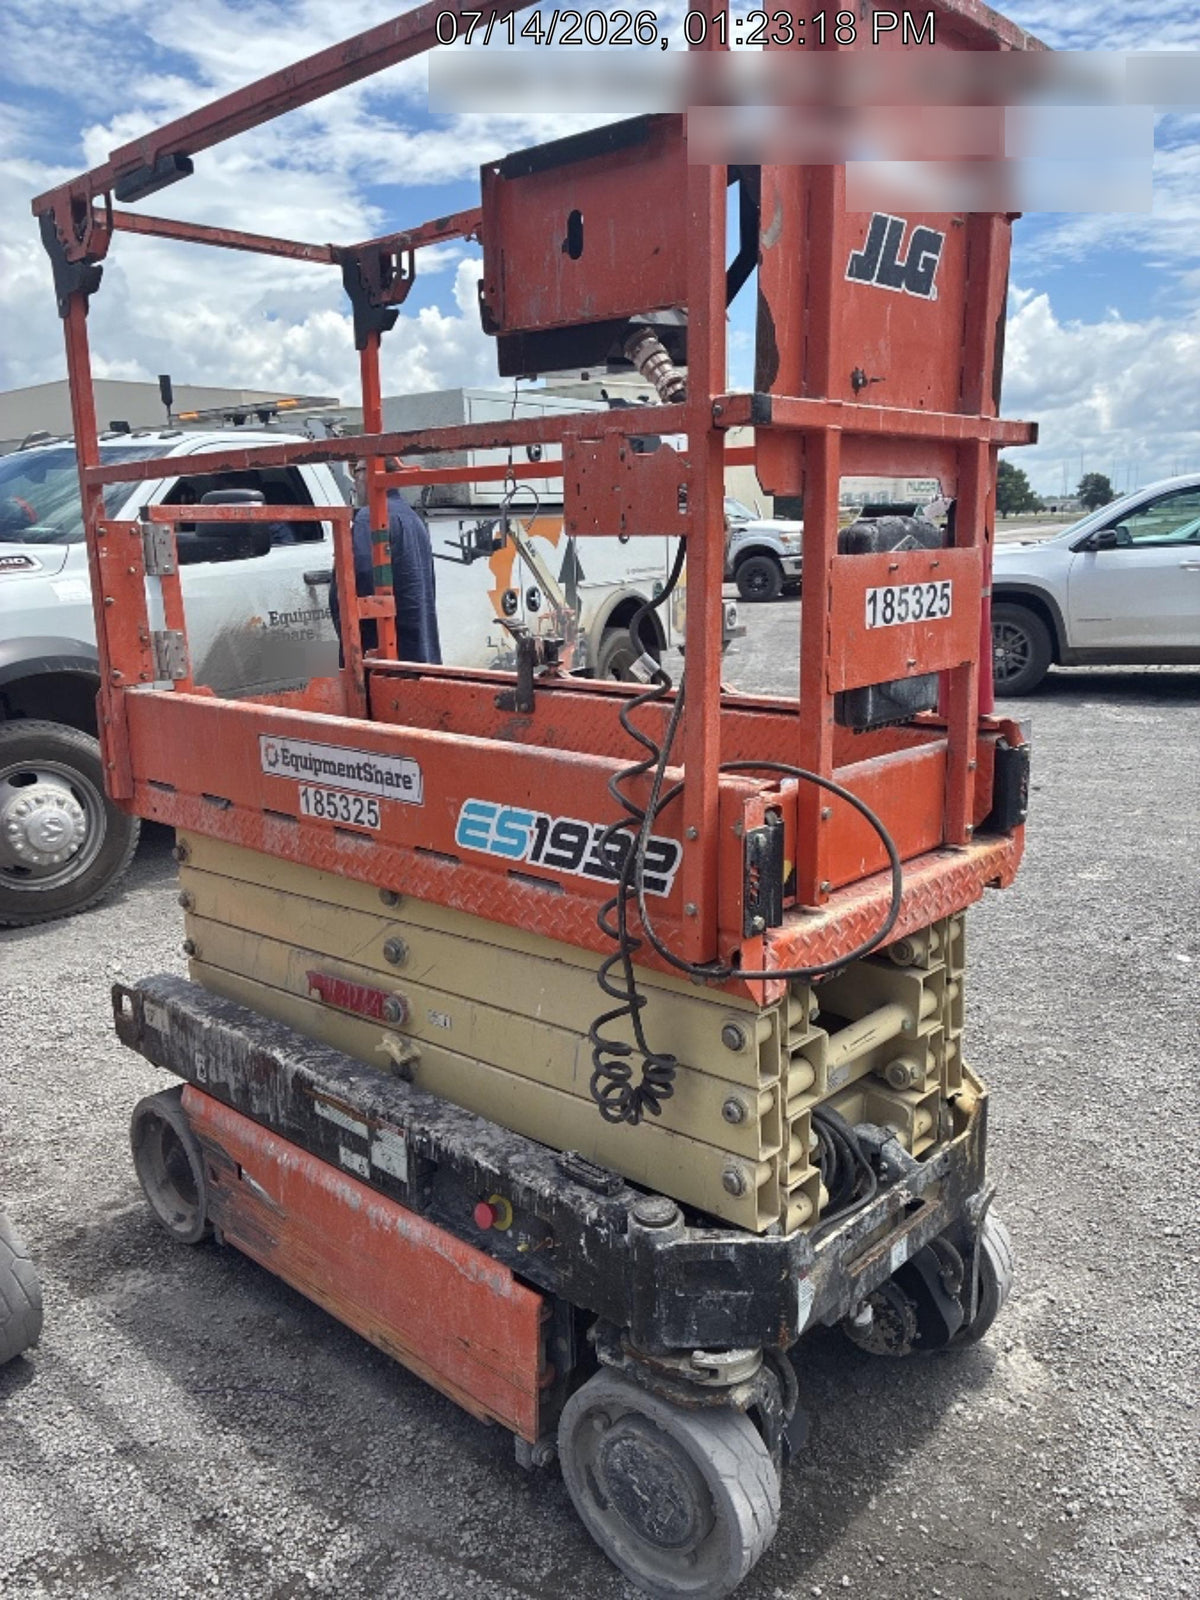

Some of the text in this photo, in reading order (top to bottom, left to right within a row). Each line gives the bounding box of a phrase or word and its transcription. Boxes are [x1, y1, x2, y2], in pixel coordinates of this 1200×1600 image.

[845, 212, 945, 300] JLG
[267, 607, 331, 627] Equipme
[867, 582, 950, 626] 185325
[280, 748, 413, 790] EquipmentShare
[301, 787, 380, 828] 185325
[456, 799, 682, 897] ES1932
